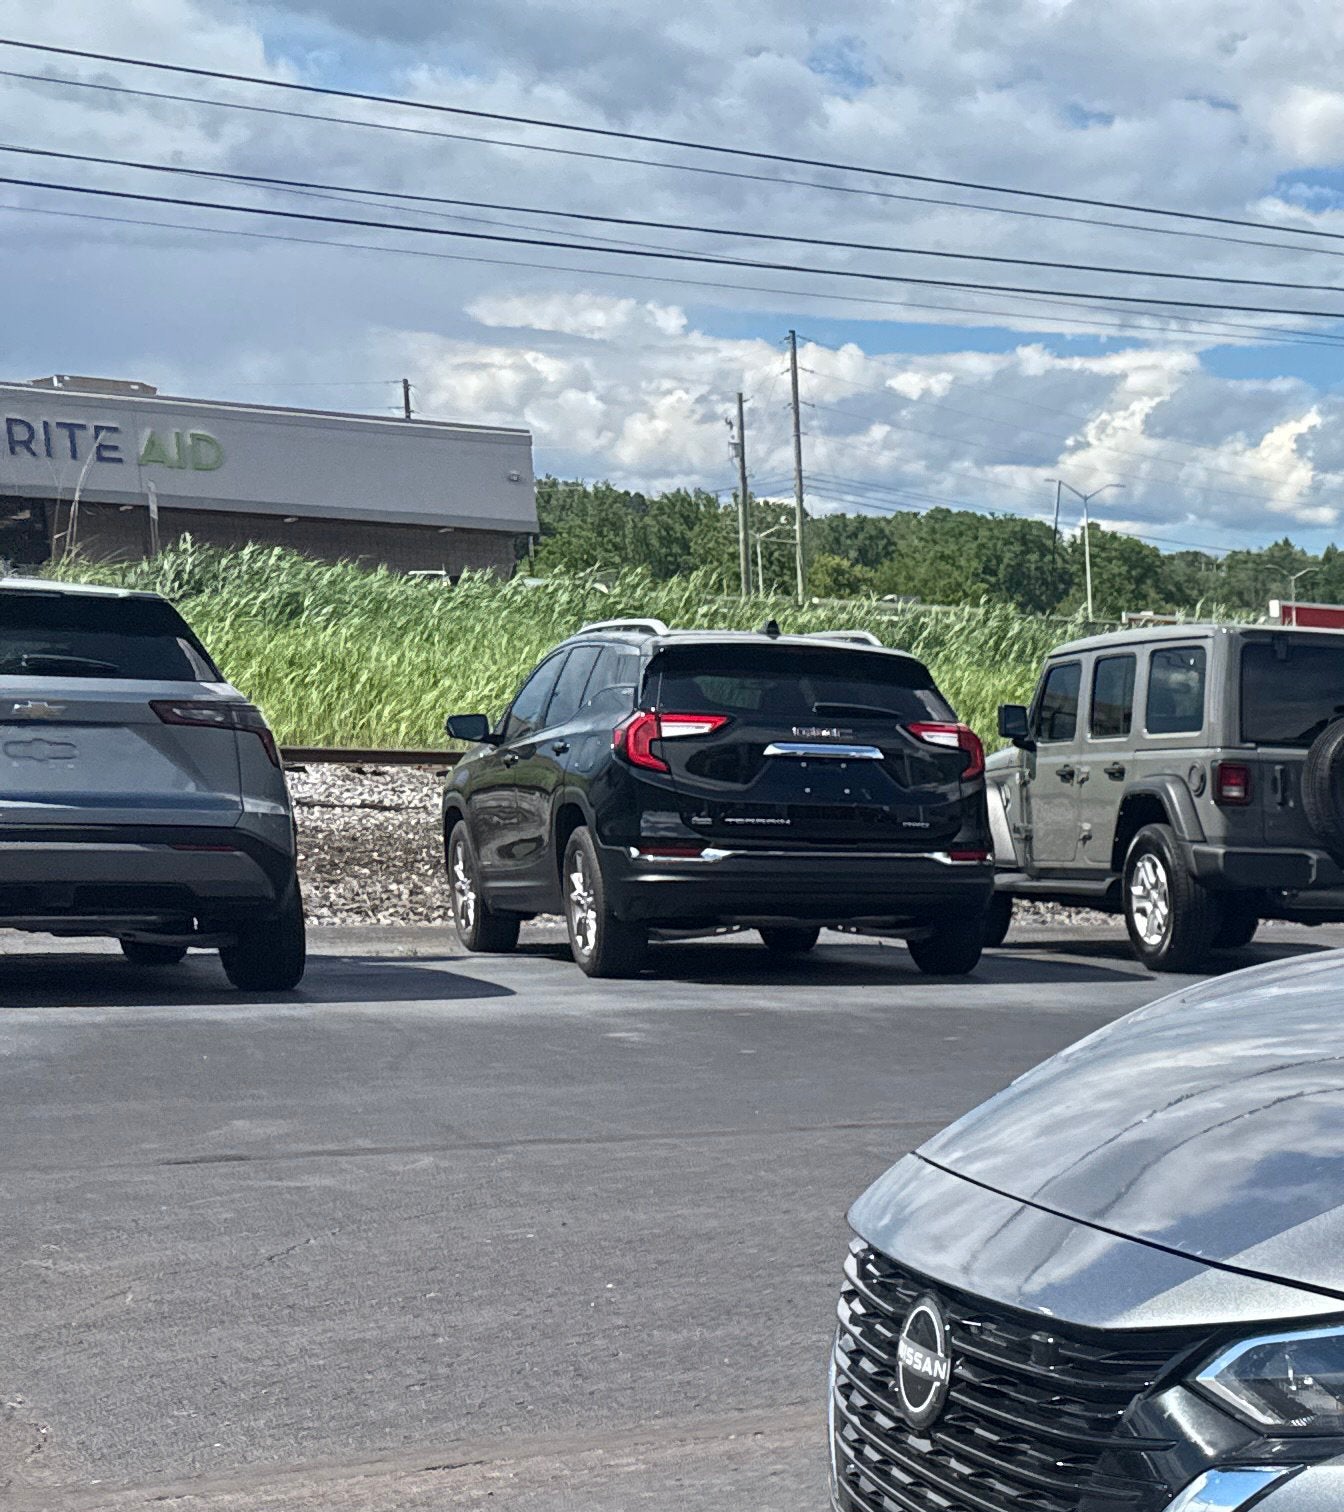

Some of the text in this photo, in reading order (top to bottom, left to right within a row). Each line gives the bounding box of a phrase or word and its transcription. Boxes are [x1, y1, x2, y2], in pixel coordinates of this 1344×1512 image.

[6, 417, 224, 471] RITE AID
[898, 1339, 947, 1380] NISSAN
